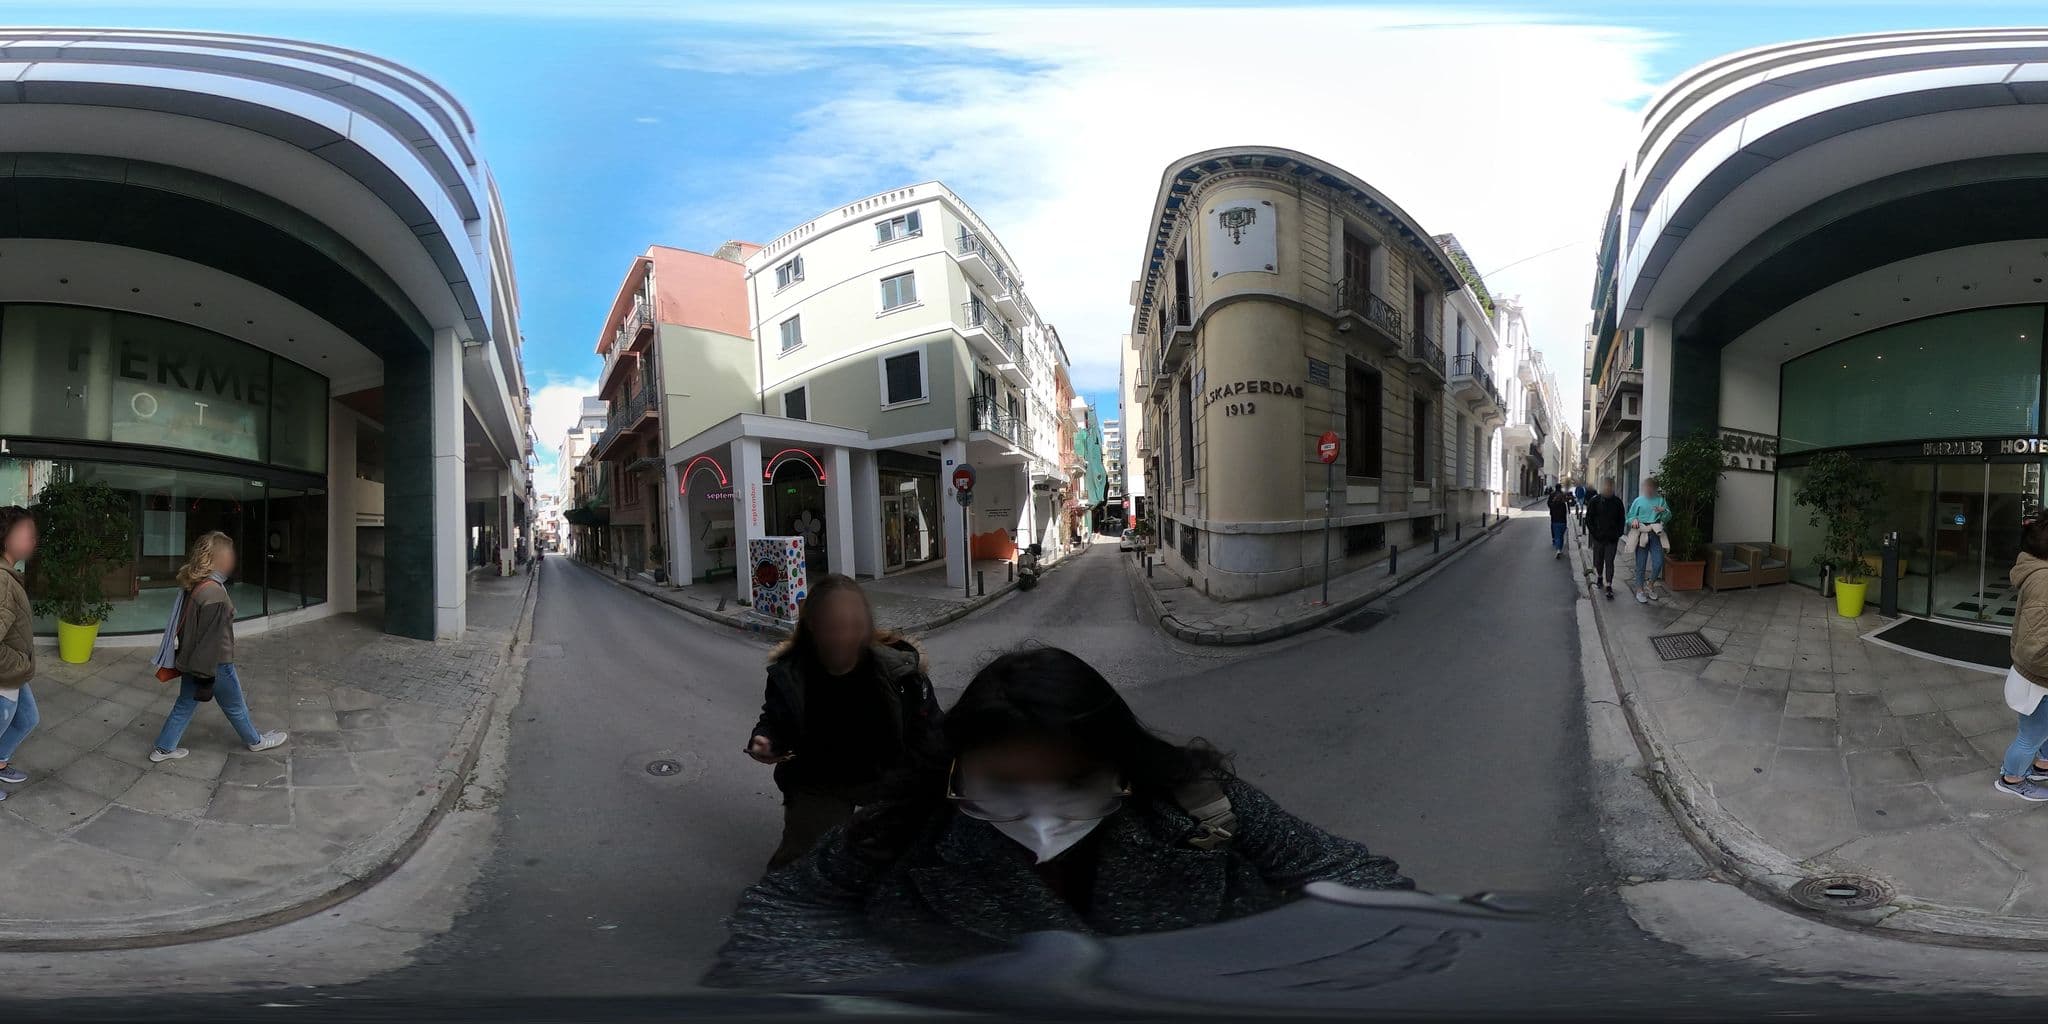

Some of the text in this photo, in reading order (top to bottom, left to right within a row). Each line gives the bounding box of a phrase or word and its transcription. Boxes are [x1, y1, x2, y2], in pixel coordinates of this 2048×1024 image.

[1226, 402, 1255, 417] 1912
[1923, 439, 2048, 456] HERMES HOTE
[706, 492, 735, 501] septem
